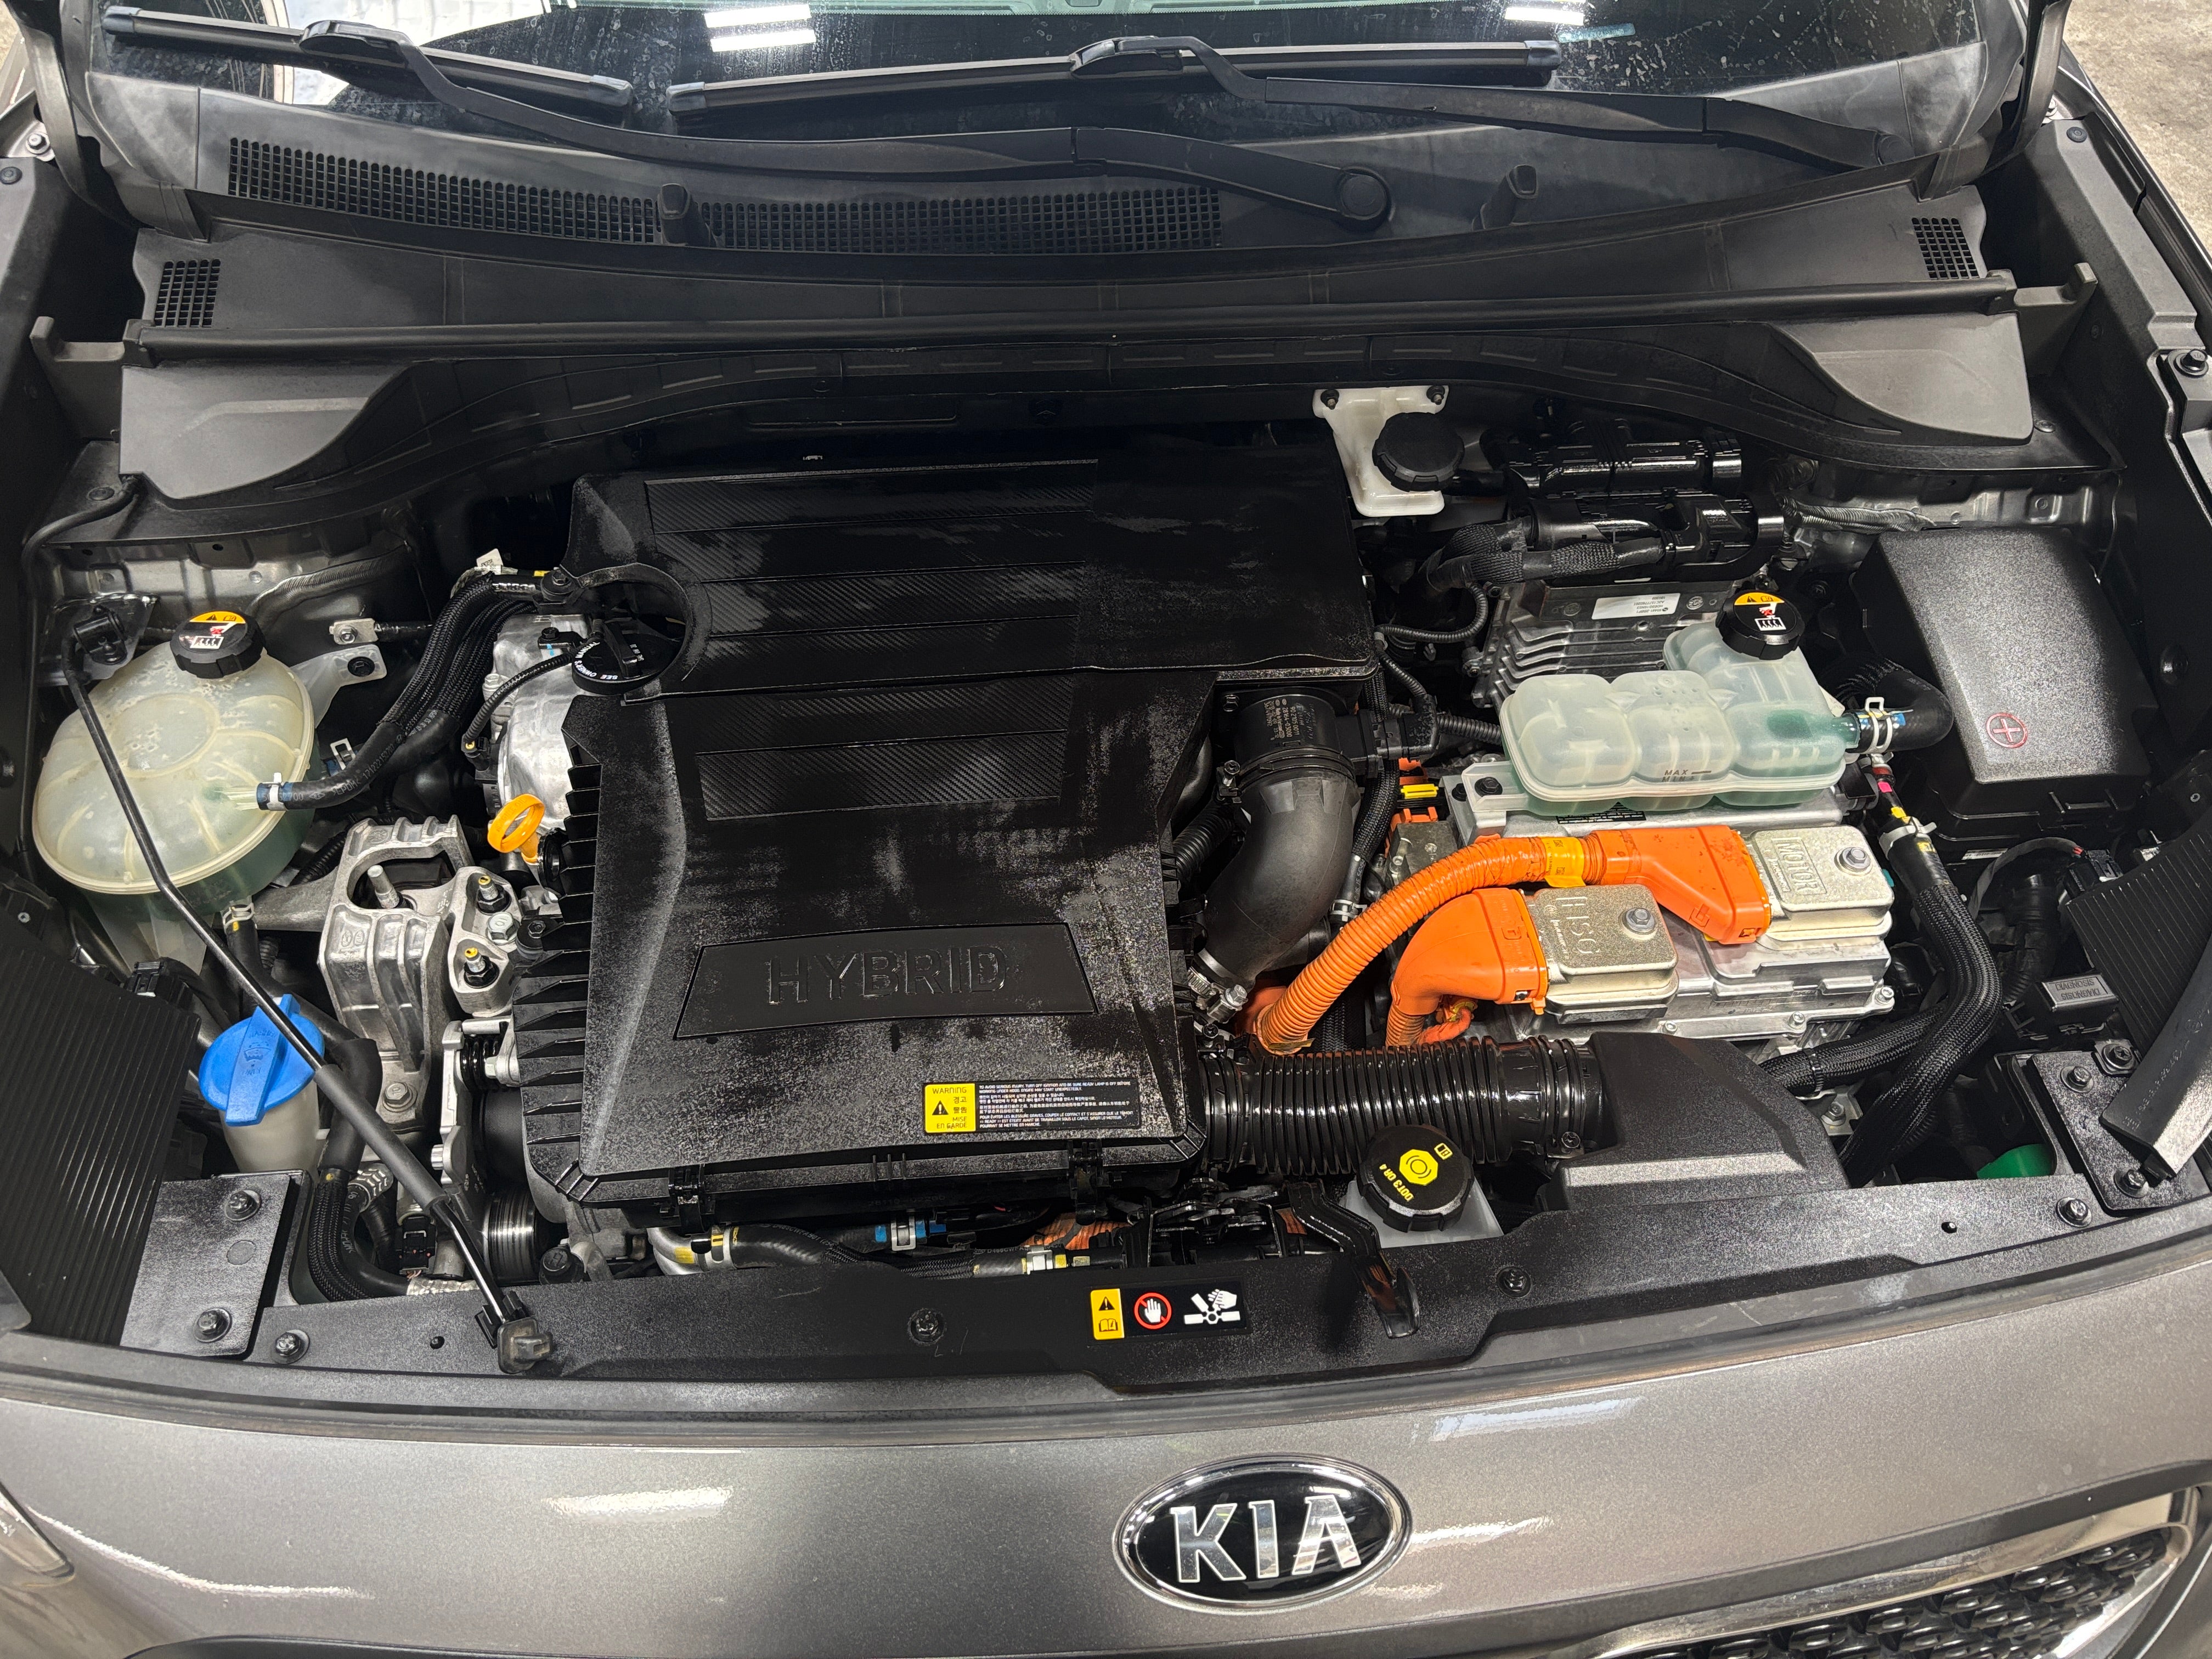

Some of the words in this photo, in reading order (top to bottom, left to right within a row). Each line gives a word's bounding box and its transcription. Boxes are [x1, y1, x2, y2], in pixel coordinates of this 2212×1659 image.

[575, 642, 600, 658] MANUAL
[574, 660, 597, 677] OWNER'S
[1776, 842, 1819, 892] MOTOR
[768, 945, 1008, 1005] HYBRID
[2055, 979, 2095, 991] DIAGNOSIS
[2061, 988, 2100, 1000] DIAGNOSIS
[1384, 1169, 1397, 1181] OR
[1169, 1494, 1361, 1583] KIA
